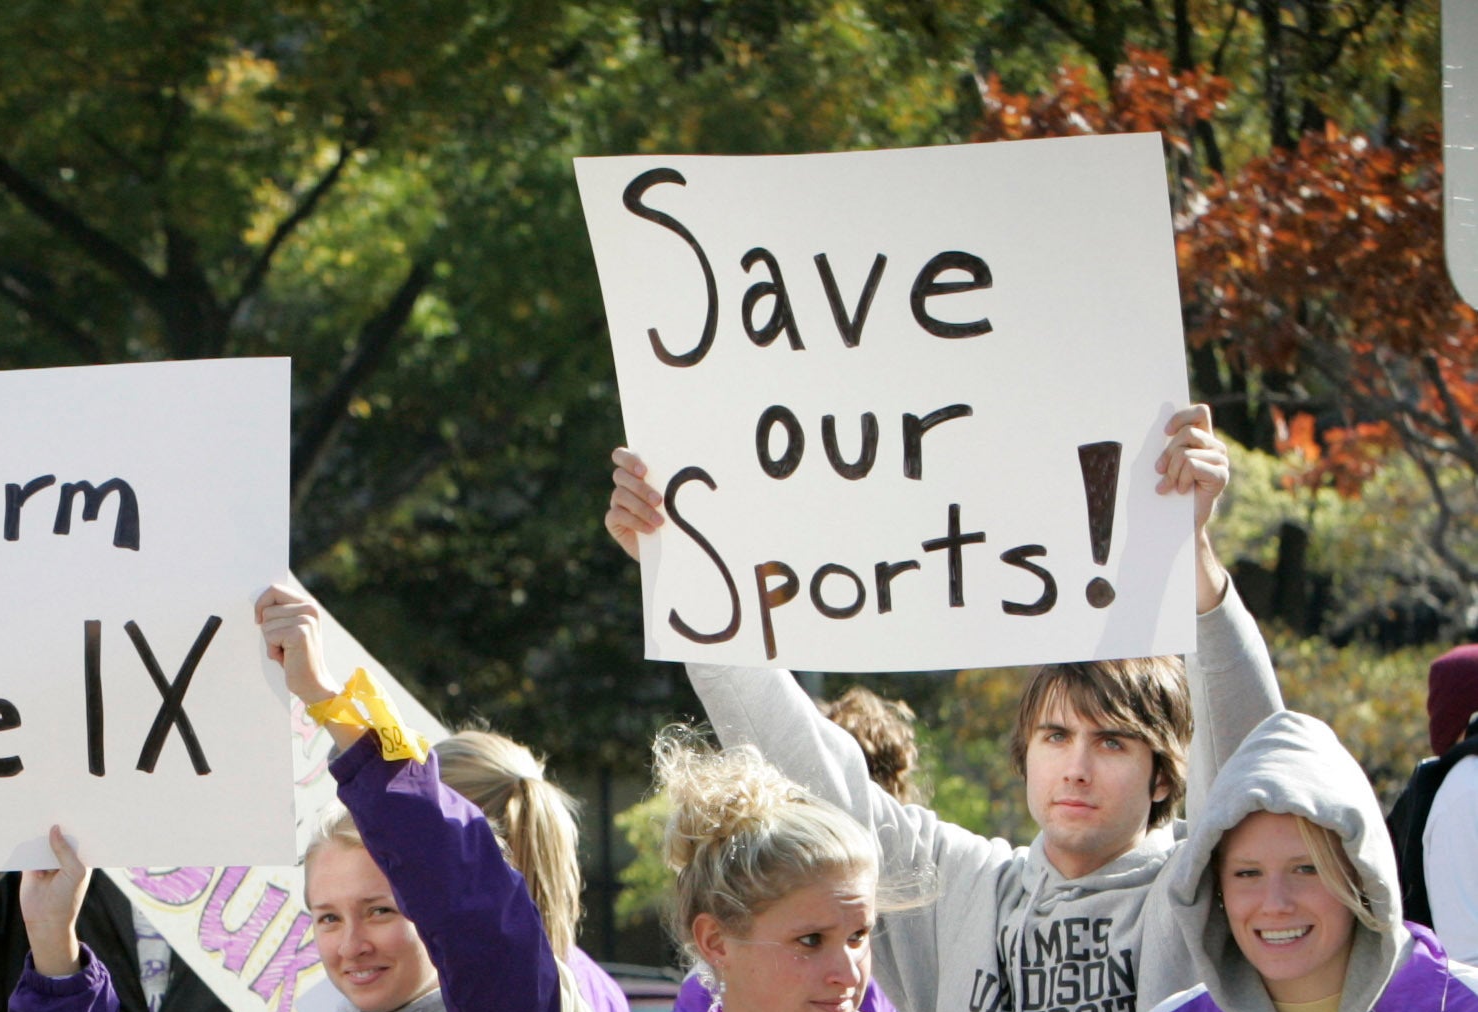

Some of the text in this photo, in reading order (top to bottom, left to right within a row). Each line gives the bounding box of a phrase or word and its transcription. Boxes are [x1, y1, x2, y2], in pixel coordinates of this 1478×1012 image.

[622, 167, 993, 368] Save
[755, 403, 974, 480] our
[663, 466, 1123, 661] Sports!
[84, 614, 223, 777] IX
[1000, 949, 1136, 1012] DISON
